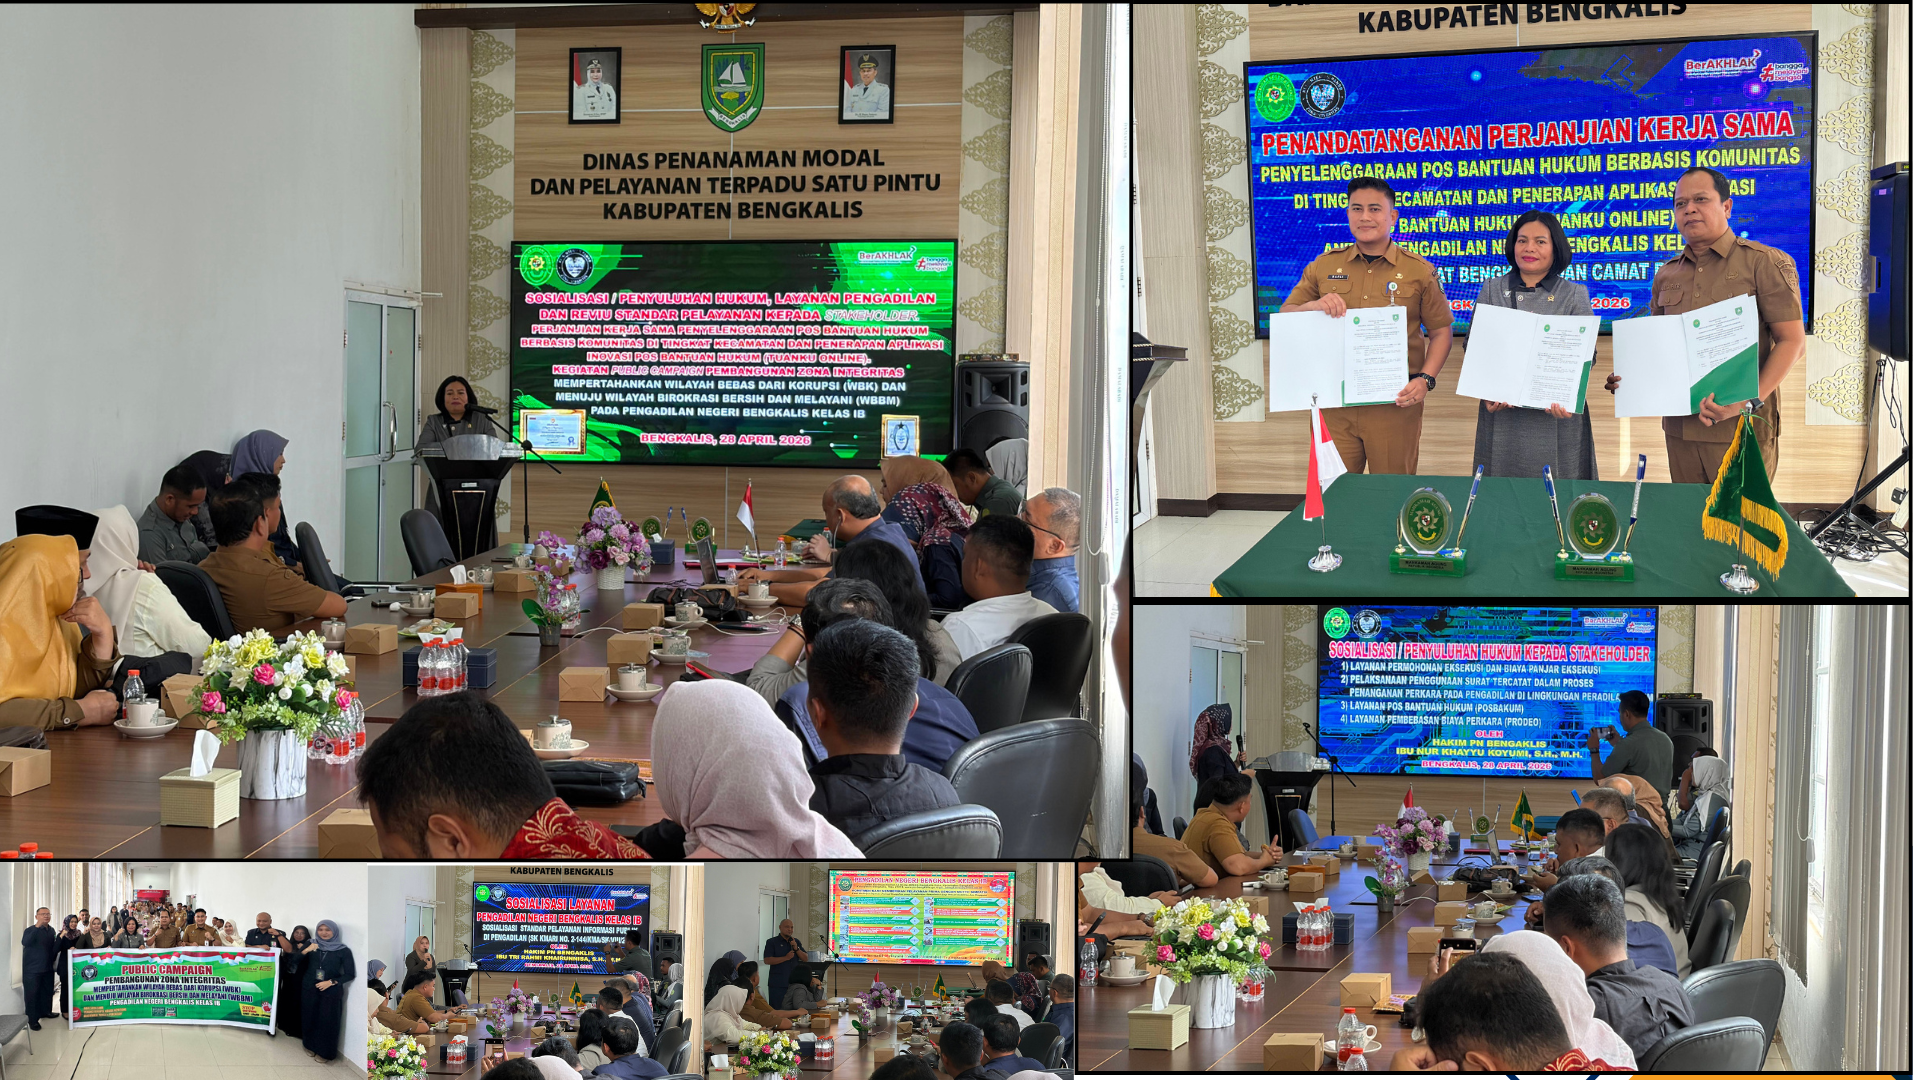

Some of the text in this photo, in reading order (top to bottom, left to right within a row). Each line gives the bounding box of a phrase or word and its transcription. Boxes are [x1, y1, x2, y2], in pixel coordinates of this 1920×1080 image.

[1358, 4, 1687, 33] KABUPATEN BENGKALIS
[1686, 57, 1756, 70] BerAKHLAK
[1262, 110, 1795, 156] PENANDATANGANAN PERJANJIAN KERJA SAMA
[583, 149, 885, 170] DINAS PENANAMAN MODAL
[1260, 146, 1801, 183] PENYELENGGARAAN POS BANTUAN HUKUM BERBASIS KOMUNITAS
[531, 173, 941, 195] DAN PELAYANAN TERPADU SATU PINTU
[1293, 180, 1676, 209] DI TING ECAMATAN DAN PENERAPAN APLIKAS
[603, 200, 863, 219] KABUPATEN BENGKALIS
[1399, 209, 1675, 234] BANTUAN HUKU ONLINE)
[1394, 234, 1649, 257] ENGADILAN ENGKALIS
[859, 250, 913, 260] BerAKHLAK
[1591, 261, 1650, 281] CAMAT
[525, 292, 936, 305] SOSIALISASI PENYULUHAN HUKUM, LAYANAN PENGADILAN
[1591, 297, 1631, 309] 2026
[539, 309, 920, 322] DAN REVIU STANDAR PELAYANAN KEPADA STAKEHOLDER.
[520, 338, 944, 350] BERBASIS KOMUNITAS DI TINGKAT KECAMATAN DAN PENERAPAN APLIKASI
[553, 379, 906, 392] MEMPERTAHANKAN WILAYAH BEBAS DARI KORUPSI (WBK) DAN
[555, 392, 900, 407] MENUJU WILAYAH BIROKRASI BERSIH DAN MELAYANI (WBBM)
[590, 406, 866, 418] PADA PENGADILAN NEGERI BENGKALIS KELAS IB
[640, 433, 811, 446] BENGKALIS, 28 APRIL 2026
[1329, 641, 1651, 662] SOSIALISASI PENYULUHAN HUKUM KEPADA STAKEHOLDER
[1341, 662, 1601, 675] 1) LAYANAN PERMOHONAN EKSEKUSI DAN BIAYA PANJAR EKSEKUSI
[1341, 675, 1594, 688] 2) PELAKSANAAN PENGGUNAAN SURAT TERCATAT DALAM PROSES
[1341, 701, 1524, 715] 3) LAYANAN POS BANTUAN HUKUM (POSBAKUM)
[1341, 715, 1542, 728] 4) LAYANAN PEMBEBASAN BIAYA PERKARA (PRODEO)
[1475, 730, 1503, 739] OLEH
[1433, 739, 1547, 748] HAKIM PN BENGAKLIS
[1421, 761, 1481, 770] BENGKALIS,
[1483, 762, 1495, 770] 28
[1497, 762, 1526, 770] APRIL
[511, 867, 614, 876] KABUPATEN BENGKALIS
[506, 897, 615, 911] SOSIALISASI LAYANAN
[477, 912, 642, 925] PENGADILAN NEGERI BENGKALIS KELAS IB
[482, 924, 518, 932] SOSIALISASI
[122, 964, 213, 975] PUBLIC CAMPAIGN
[104, 976, 226, 985] PEMBANGUNAN ZONA INTEGRITAS
